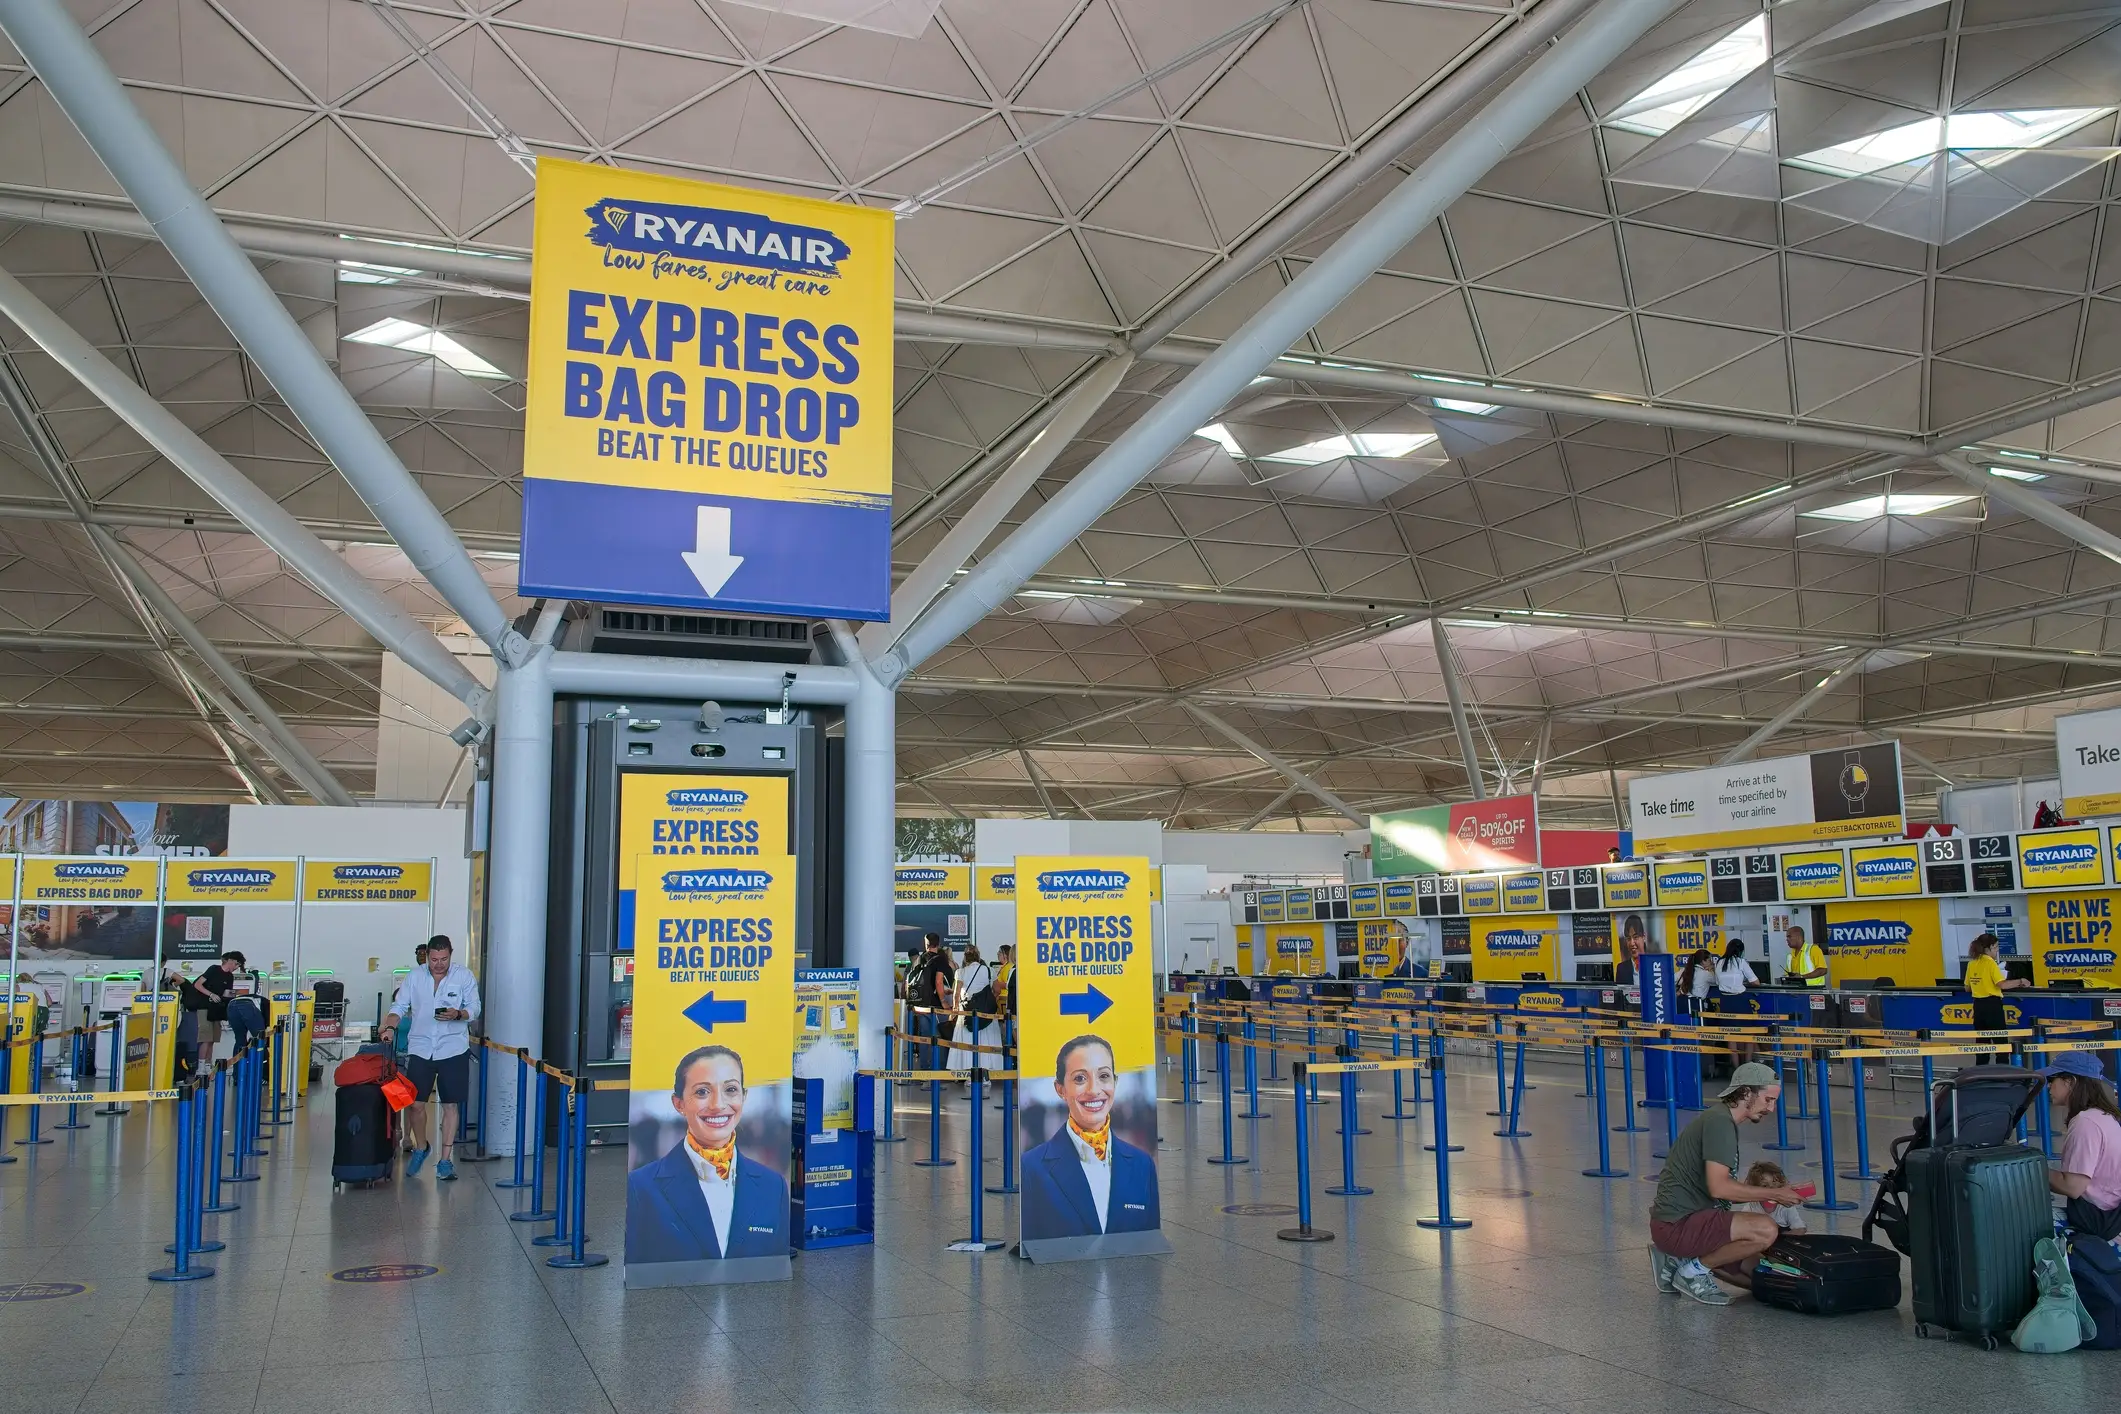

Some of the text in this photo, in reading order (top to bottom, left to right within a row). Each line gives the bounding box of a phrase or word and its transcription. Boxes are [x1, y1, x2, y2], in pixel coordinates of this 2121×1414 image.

[634, 212, 834, 267] RYANAIR
[603, 244, 831, 297] Low fares, great care
[566, 290, 859, 384] EXPRESS
[564, 360, 859, 445] BAG DROP
[597, 429, 828, 478] BEAT THE QUEUES
[2076, 745, 2120, 766] Take
[1726, 774, 1776, 788] Arrive at the
[681, 793, 744, 802] RYANAIR
[1718, 788, 1787, 804] time specified by
[1641, 798, 1694, 817] Take time
[1730, 806, 1776, 820] your airline
[129, 820, 179, 849] Your
[653, 820, 759, 842] EXPRESS
[1813, 821, 1896, 835] #LETSGETBACKTOTRAVEL
[902, 833, 939, 862] Your
[1491, 837, 1515, 845] SPIRITS
[1933, 842, 1954, 860] 53
[1978, 838, 2000, 858] 52
[2036, 849, 2093, 861] RYANAIR
[67, 866, 125, 875] RYANAIR
[1717, 858, 1734, 874] 55
[1752, 857, 1769, 872] 54
[1866, 862, 1912, 872] RYANAIR
[2060, 864, 2078, 873] great
[203, 873, 270, 883] RYANAIR
[345, 868, 401, 877] RYANAIR
[1552, 872, 1564, 885] 57
[1578, 870, 1592, 883] 56
[1611, 872, 1643, 881] RYANAIR
[1795, 867, 1838, 877] RYANAIR
[681, 875, 766, 887] RYANAIR
[1054, 876, 1124, 886] RYANAIR
[1443, 879, 1454, 892] 58
[1665, 875, 1702, 884] RYANAIR
[37, 887, 143, 899] EXPRESS BAG DROP
[1318, 888, 1325, 899] 61
[1334, 887, 1343, 898] 60
[1422, 881, 1431, 893] 59
[317, 889, 416, 899] EXPRESS BAG DROP
[669, 891, 686, 900] Low
[689, 890, 714, 903] fares,
[716, 891, 742, 904] great
[1060, 891, 1082, 901] fares,
[1083, 892, 1105, 902] great
[1247, 893, 1254, 903] 62
[1510, 895, 1538, 905] BAG DROP
[1611, 889, 1641, 900] BAG DROP
[1479, 898, 1493, 906] DROP
[2047, 899, 2111, 918] CAN WE
[1036, 916, 1132, 939] EXPRESS
[1677, 914, 1718, 929] CAN WE
[659, 918, 772, 943] EXPRESS
[1364, 924, 1377, 936] CAN
[1378, 924, 1388, 935] WE
[1833, 927, 1907, 940] RYANAIR
[2048, 920, 2112, 944] HELP?
[1364, 938, 1388, 951] HELP?
[1495, 935, 1539, 945] RYANAIR
[1678, 931, 1719, 949] HELP?
[658, 946, 772, 968] BAG DROP
[1037, 941, 1133, 963] BAG DROP
[1828, 945, 1906, 959] ow fares, great care
[2056, 954, 2112, 962] RYANAIR
[670, 970, 759, 982] BEAT THE QUEUES
[1048, 964, 1123, 976] BEAT THE QUEUES
[1387, 990, 1414, 999] RYANAIR
[1653, 962, 1664, 1024] RYANAIR
[1526, 996, 1561, 1005] RYANAIR
[129, 1043, 149, 1056] RYANAIR
